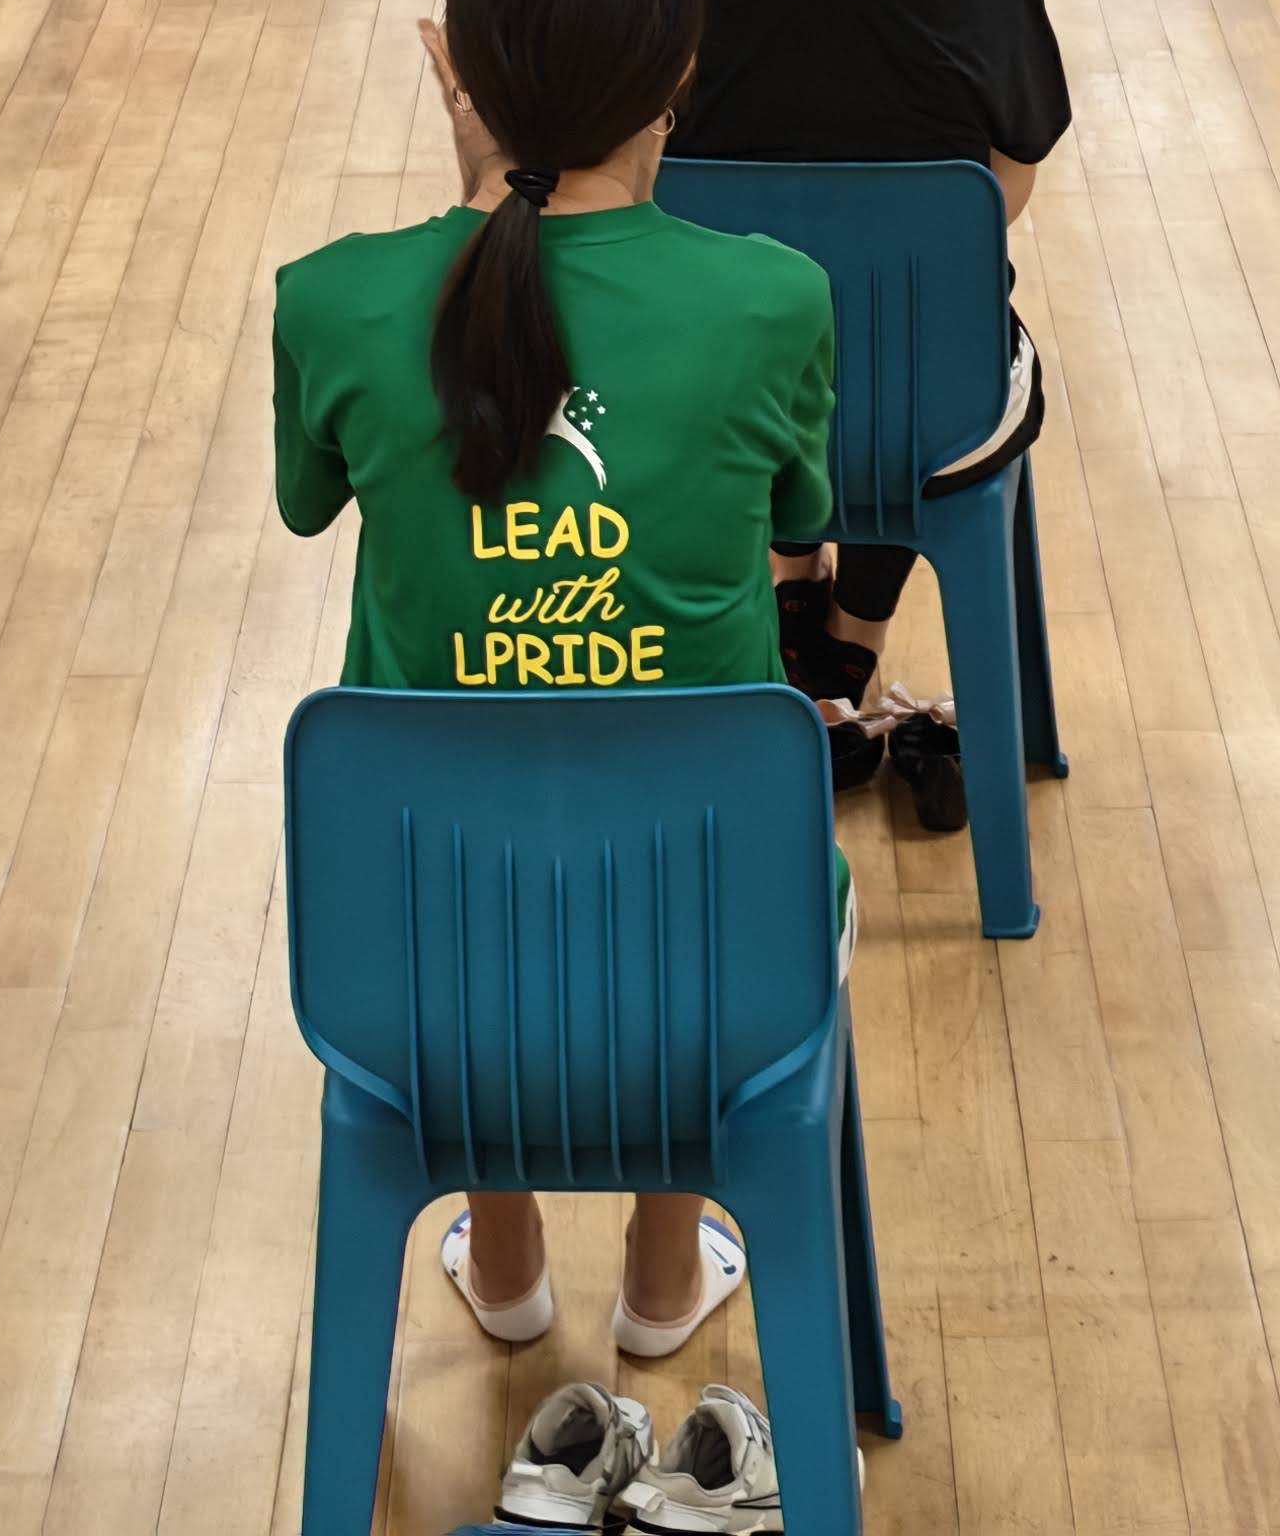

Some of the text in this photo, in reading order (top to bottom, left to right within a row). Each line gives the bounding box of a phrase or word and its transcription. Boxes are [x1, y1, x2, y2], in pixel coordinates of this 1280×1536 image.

[471, 501, 630, 560] LEAD
[487, 566, 625, 625] with
[453, 625, 666, 686] LPRIDE
